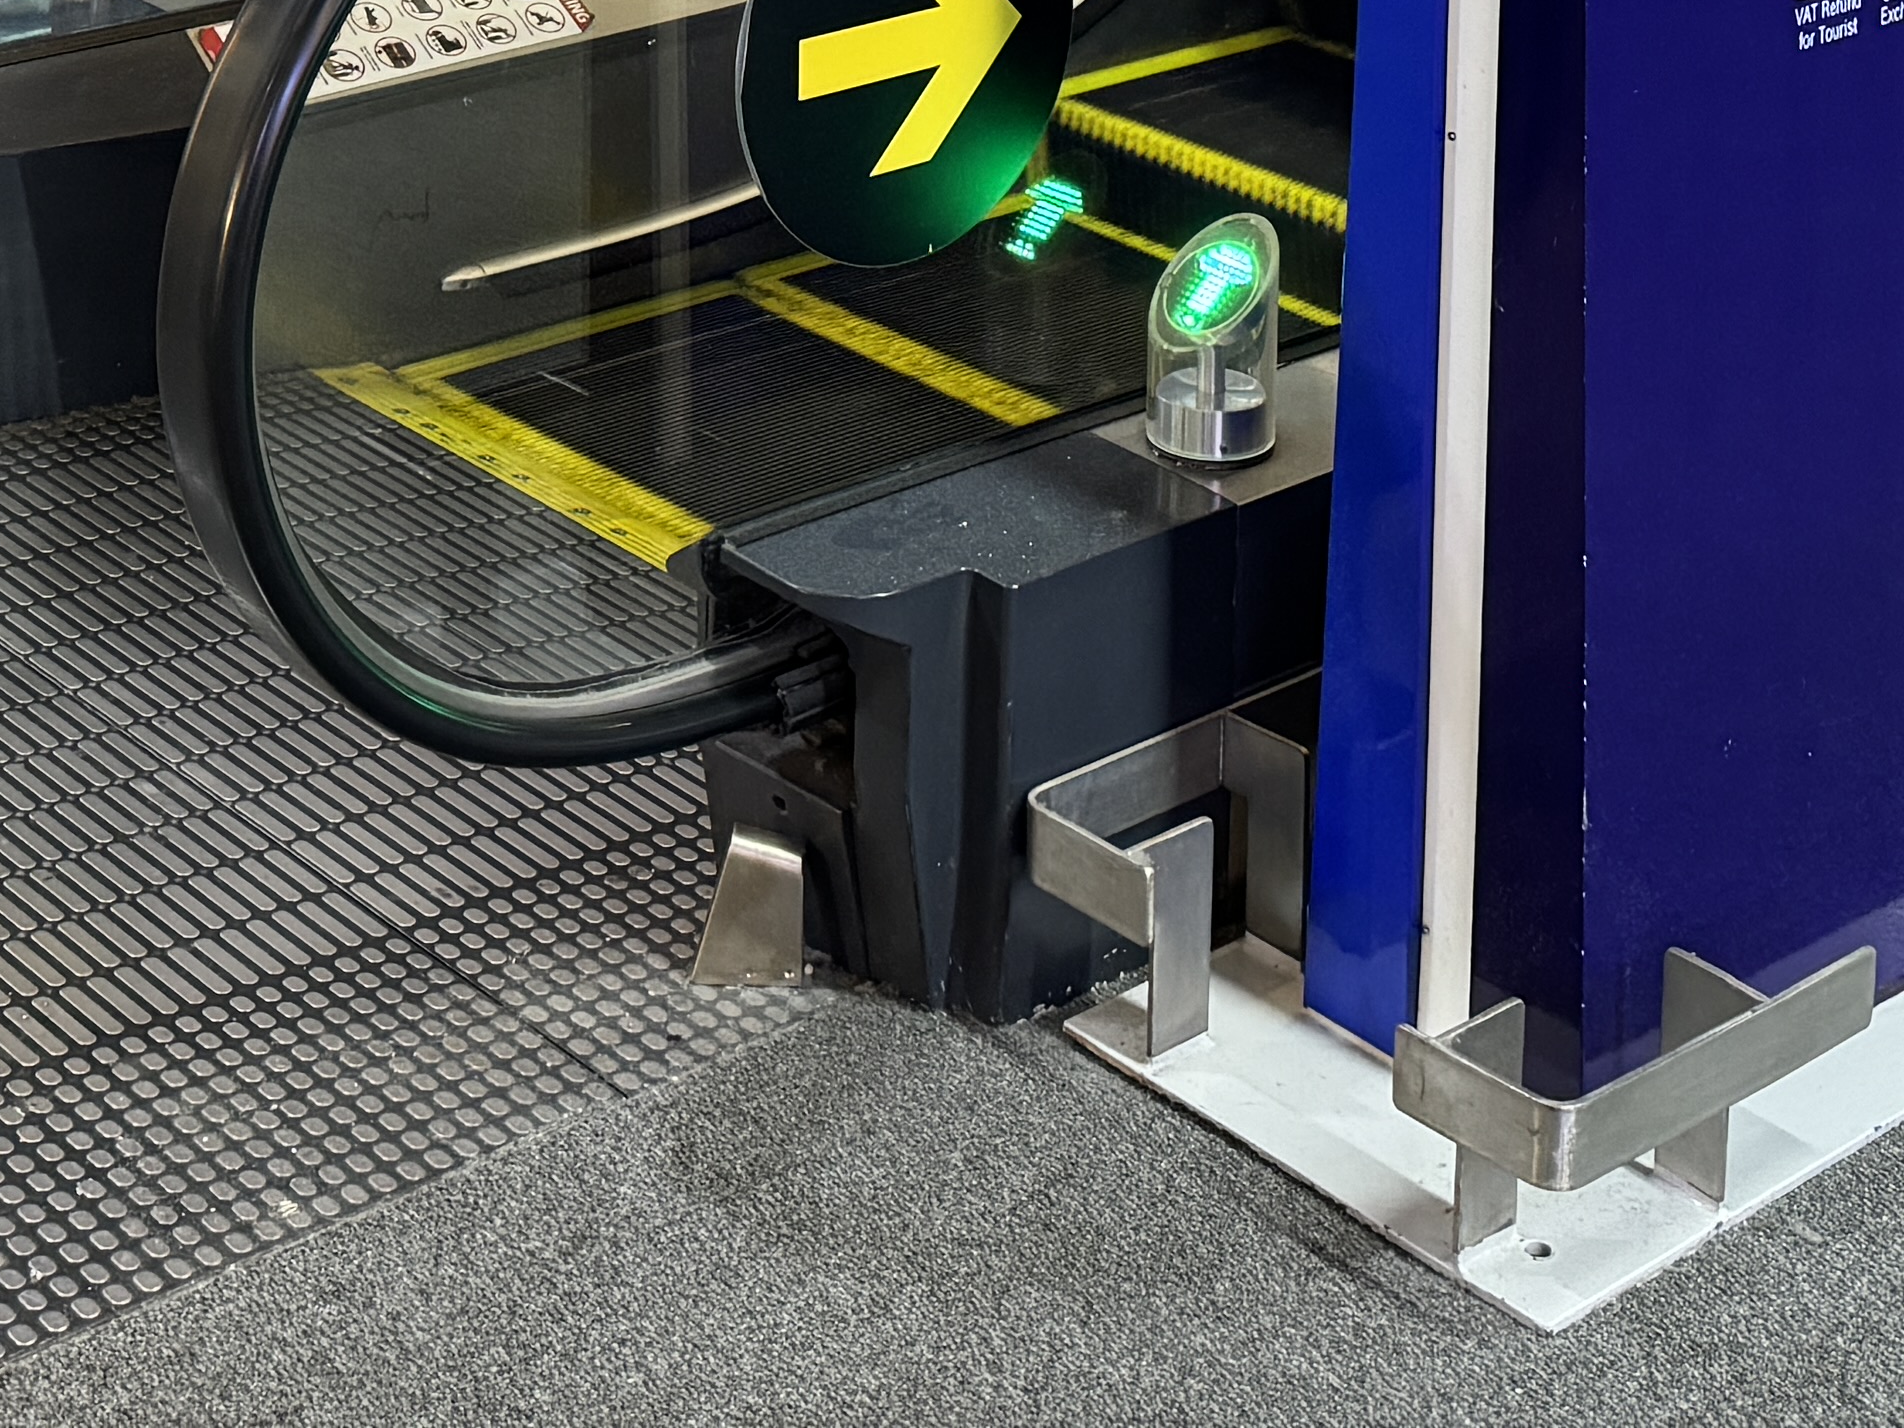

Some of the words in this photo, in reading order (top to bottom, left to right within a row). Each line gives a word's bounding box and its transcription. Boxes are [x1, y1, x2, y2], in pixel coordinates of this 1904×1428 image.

[1795, 3, 1818, 26] VAT
[1799, 30, 1815, 51] for
[1818, 17, 1858, 45] Tourist
